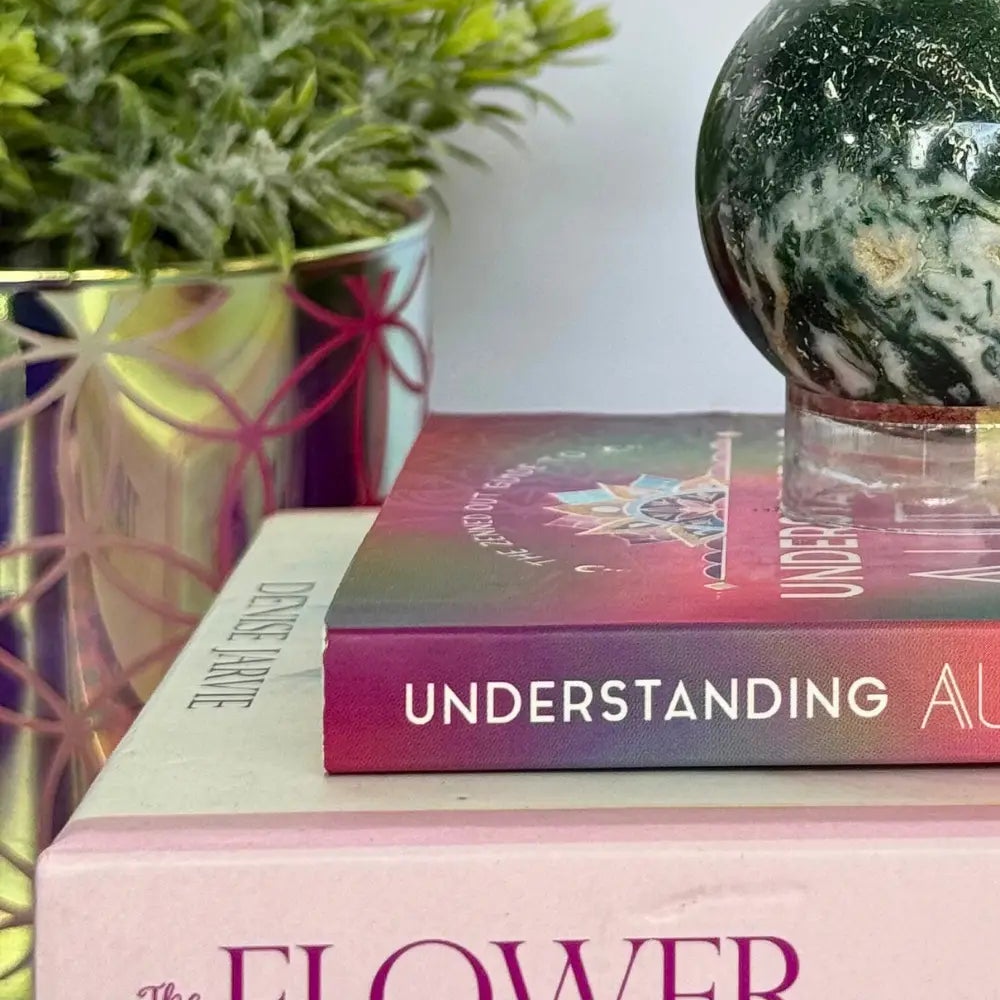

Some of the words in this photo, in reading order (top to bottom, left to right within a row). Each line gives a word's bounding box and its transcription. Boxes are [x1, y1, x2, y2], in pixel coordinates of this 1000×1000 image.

[463, 513, 514, 547] ZENNED
[496, 548, 556, 567] THE
[227, 581, 317, 641] DENISE
[186, 647, 282, 710] JARVIE
[403, 676, 890, 726] UNDERSTANDING
